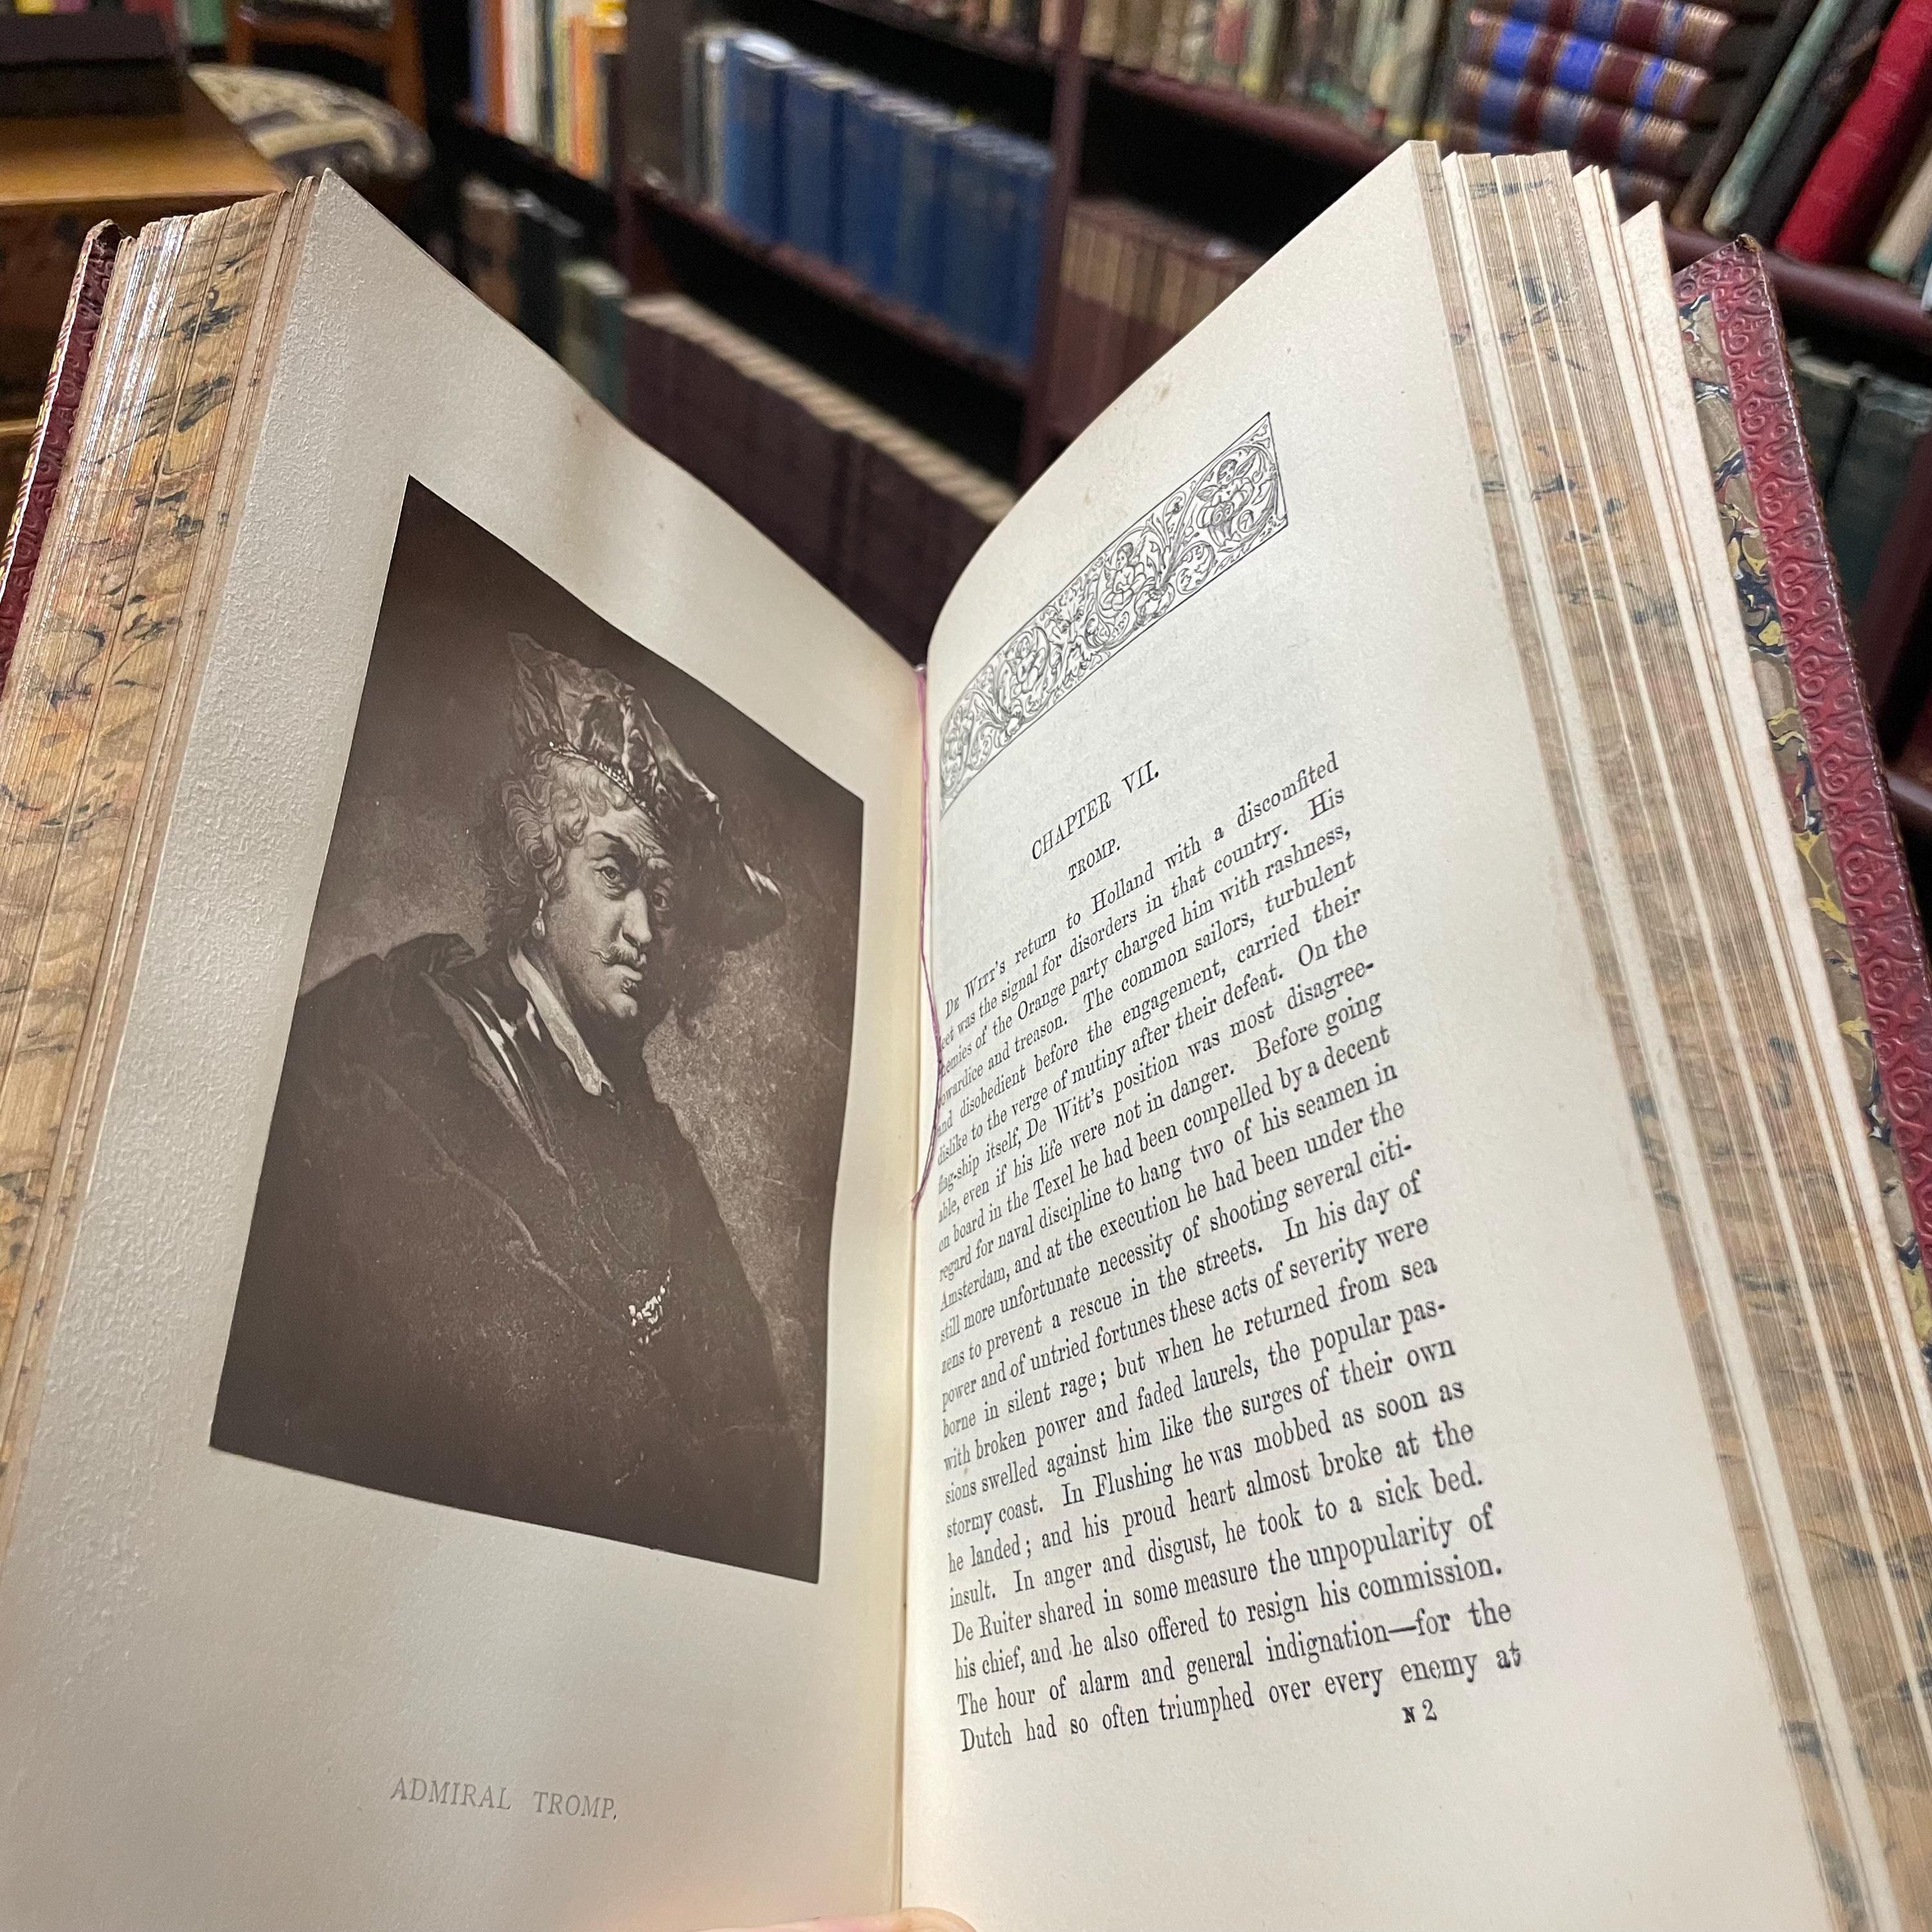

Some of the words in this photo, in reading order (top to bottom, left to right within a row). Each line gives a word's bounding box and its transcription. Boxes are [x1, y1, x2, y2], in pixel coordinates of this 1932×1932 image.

[1015, 929, 1056, 964] return
[1090, 861, 1154, 914] Holland
[1164, 836, 1202, 869] with
[1238, 751, 1339, 827] discomfited
[1032, 791, 1112, 860] CHAPTER
[1121, 760, 1159, 793] VII.
[1068, 838, 1120, 880] TROMP.
[958, 1012, 975, 1035] was
[1001, 963, 1038, 1003] signal
[1070, 909, 1137, 958] disorders
[1171, 865, 1206, 898] that
[1215, 824, 1288, 873] country.
[1307, 788, 1344, 820] His
[976, 1025, 987, 1049] of
[1018, 983, 1065, 1019] Orange
[1070, 957, 1108, 996] party
[1115, 913, 1177, 963] charged
[1181, 900, 1215, 926] him
[1265, 826, 1350, 879] rashness,
[989, 1041, 1010, 1070] and
[1014, 1016, 1067, 1052] treason.
[1084, 987, 1113, 1012] The
[1122, 947, 1188, 992] common
[1195, 913, 1254, 952] sailors,
[1265, 851, 1355, 913] turbulent
[960, 1064, 1026, 1118] disobedient
[1034, 1039, 1078, 1073] before
[1087, 1021, 1112, 1043] the
[1123, 959, 1226, 1023] engagement,
[1237, 914, 1300, 963] carried
[1312, 886, 1361, 923] their
[971, 1123, 983, 1140] to
[1011, 1087, 1048, 1115] verge
[1072, 1045, 1126, 1084] mutiny
[1132, 1023, 1170, 1052] after
[1224, 963, 1283, 1005] defeat.
[1298, 944, 1329, 966] On
[986, 1127, 1021, 1162] itself,
[1025, 1118, 1046, 1141] De
[1053, 1088, 1103, 1123] Witt's
[1113, 1054, 1179, 1102] position
[1229, 1001, 1274, 1037] most
[1287, 963, 1374, 1009] disagree-
[989, 1203, 1002, 1222] in
[1034, 1164, 1075, 1200] Texel
[1102, 1137, 1133, 1168] had
[1184, 1074, 1274, 1132] compelled
[1276, 1066, 1302, 1092] by
[1324, 1025, 1390, 1069] decent
[996, 1164, 1007, 1187] if
[1039, 1139, 1063, 1165] life
[1114, 1100, 1141, 1128] not
[1171, 1063, 1234, 1101] danger.
[1253, 1023, 1318, 1063] Before
[1326, 992, 1383, 1036] going
[998, 1215, 1035, 1249] naval
[1039, 1188, 1111, 1229] discipline
[1138, 1157, 1182, 1186] hang
[1190, 1140, 1223, 1164] two
[1259, 1106, 1290, 1133] his
[1296, 1077, 1370, 1119] seamen
[964, 1305, 995, 1330] more
[999, 1265, 1090, 1313] unfortunate
[1098, 1233, 1173, 1276] necessity
[1210, 1188, 1288, 1232] shooting
[1294, 1151, 1363, 1198] several
[1370, 1134, 1412, 1168] citi-
[1047, 1238, 1062, 1260] at
[1101, 1195, 1181, 1238] execution
[1184, 1182, 1206, 1204] he
[1212, 1159, 1248, 1192] had
[1251, 1147, 1300, 1176] been
[1304, 1118, 1363, 1154] under
[981, 1361, 1007, 1389] and
[1030, 1332, 1090, 1370] untried
[1170, 1294, 1215, 1322] these
[1222, 1276, 1258, 1304] acts
[1290, 1237, 1367, 1280] severity
[1374, 1218, 1428, 1247] were
[986, 1316, 1042, 1359] prevent
[1070, 1292, 1122, 1322] rescue
[1131, 1278, 1150, 1300] in
[1197, 1238, 1262, 1276] streets.
[1283, 1217, 1309, 1242] In
[1354, 1188, 1390, 1215] day
[1008, 1382, 1051, 1414] silent
[1114, 1351, 1146, 1379] but
[1155, 1337, 1204, 1365] when
[1244, 1285, 1330, 1336] returned
[1338, 1273, 1390, 1303] from
[1401, 1258, 1437, 1282] sea
[974, 1431, 1027, 1460] broken
[1035, 1413, 1086, 1448] power
[1137, 1375, 1184, 1410] faded
[1191, 1354, 1258, 1392] laurels,
[1310, 1313, 1391, 1363] popular
[1397, 1301, 1445, 1335] pas-
[981, 1455, 1038, 1492] swelled
[1047, 1438, 1107, 1477] against
[1159, 1415, 1193, 1441] like
[1242, 1384, 1302, 1416] surges
[1340, 1350, 1393, 1385] their
[1407, 1340, 1456, 1367] own
[999, 1494, 1043, 1523] coast.
[1092, 1462, 1173, 1497] Flushing
[1208, 1443, 1242, 1465] was
[1254, 1409, 1331, 1453] mobbed
[1376, 1392, 1428, 1419] soon
[1439, 1382, 1464, 1403] as
[950, 1579, 996, 1609] insult.
[1045, 1562, 1092, 1589] anger
[1148, 1528, 1215, 1564] disgust,
[1257, 1503, 1303, 1535] took
[1349, 1496, 1363, 1513] a
[1429, 1460, 1483, 1494] bed.
[1082, 1513, 1109, 1539] his
[1186, 1479, 1236, 1513] heart
[1246, 1459, 1311, 1497] almost
[1318, 1443, 1382, 1477] broke
[1396, 1431, 1419, 1458] at
[952, 1622, 974, 1644] De
[978, 1610, 1032, 1638] Ruiter
[1039, 1592, 1095, 1625] shared
[1133, 1582, 1178, 1605] some
[1184, 1563, 1258, 1595] measure
[1307, 1517, 1452, 1570] unpopularity
[982, 1645, 1025, 1674] chief,
[1072, 1634, 1093, 1658] he
[1104, 1625, 1138, 1651] also
[1148, 1607, 1209, 1643] offered
[1245, 1591, 1309, 1624] resign
[1358, 1554, 1502, 1600] commission.
[958, 1692, 988, 1716] The
[995, 1687, 1035, 1710] hour
[1050, 1675, 1066, 1700] of
[1079, 1670, 1130, 1695] alarm
[1187, 1640, 1254, 1685] general
[960, 1722, 1012, 1752] Dutch
[1070, 1718, 1088, 1735] so
[1159, 1681, 1255, 1721] triumphed
[1269, 1681, 1311, 1703] over
[1325, 1669, 1383, 1697] every
[1401, 1654, 1477, 1683] enemy
[1401, 1706, 1416, 1723] N
[1422, 1699, 1437, 1721] 2
[390, 1777, 511, 1810] ADMIRAL
